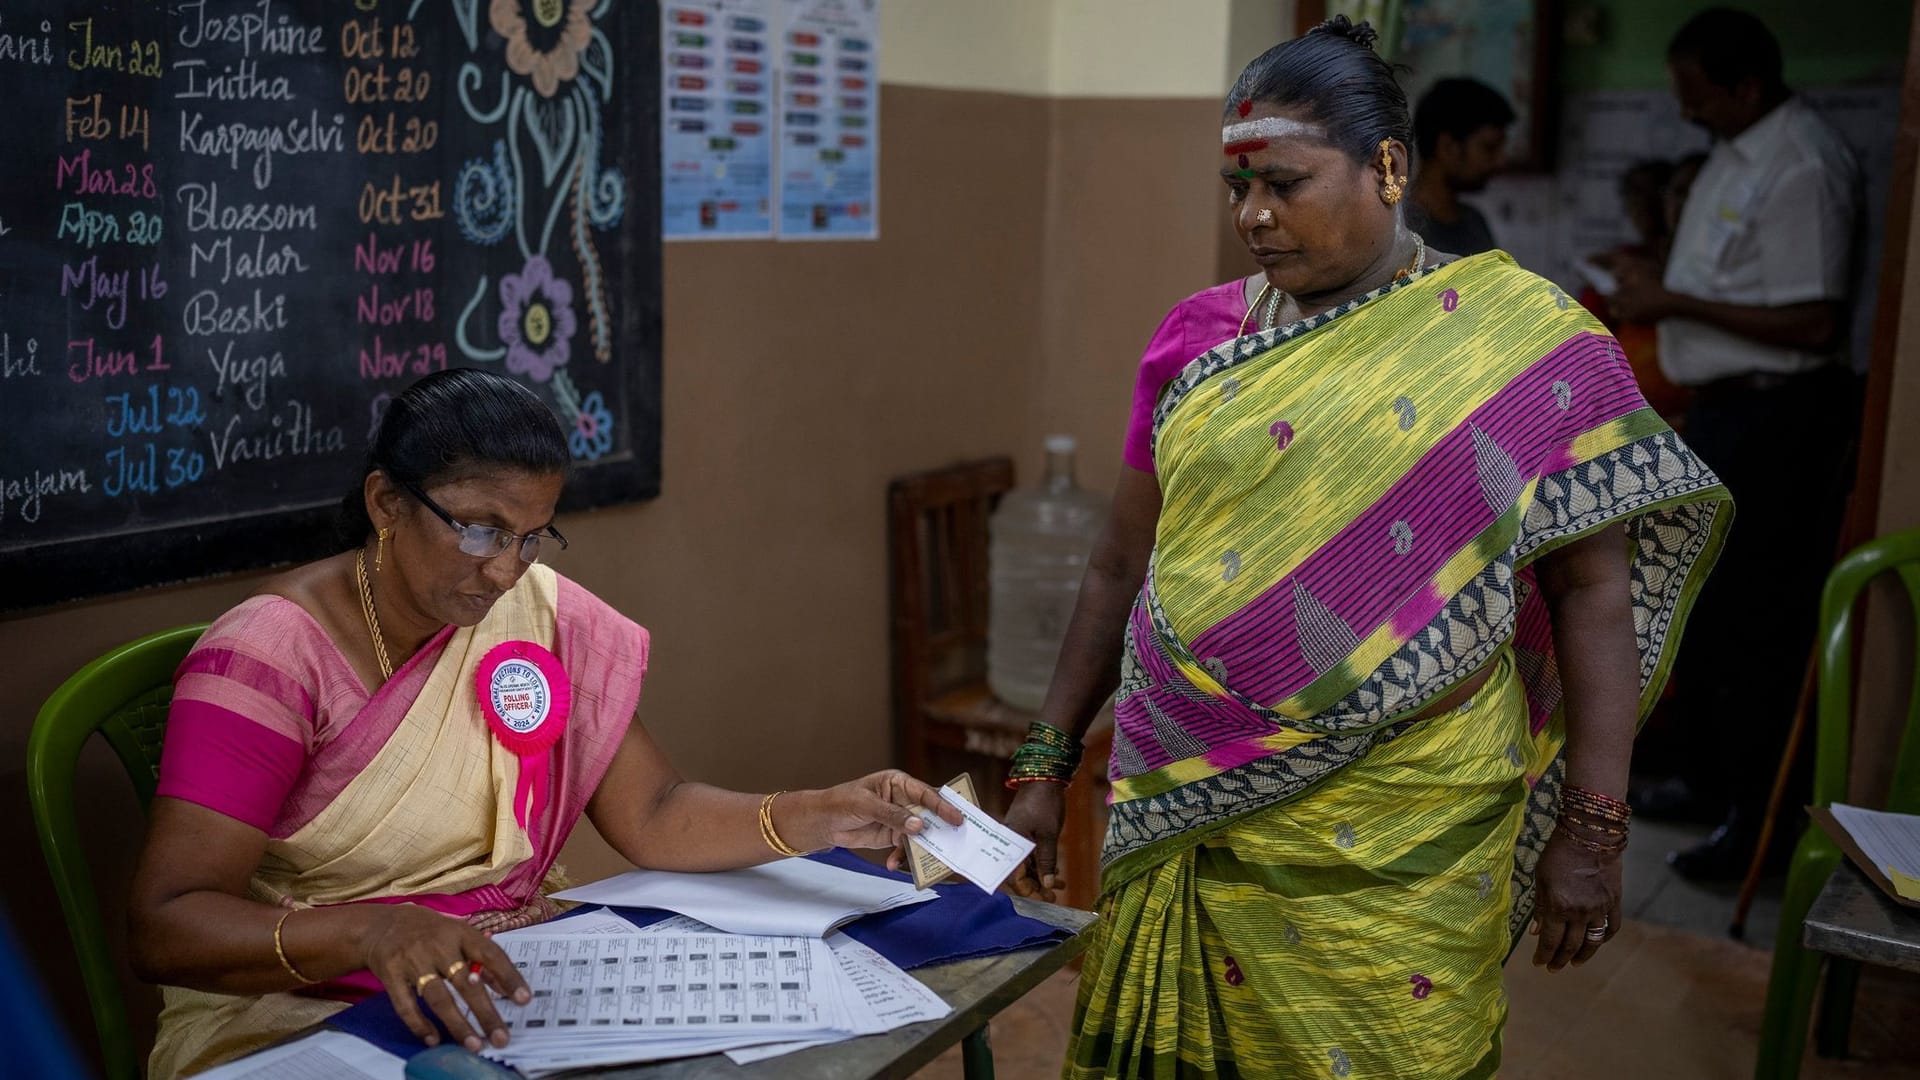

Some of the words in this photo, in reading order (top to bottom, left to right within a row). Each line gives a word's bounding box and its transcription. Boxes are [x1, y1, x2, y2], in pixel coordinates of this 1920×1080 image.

[0, 19, 54, 65] ani
[68, 17, 124, 71] Jan
[128, 40, 163, 78] 22
[178, 0, 326, 57] Josphine
[342, 17, 384, 58] Oct
[391, 23, 420, 58] 12
[173, 59, 296, 101] Initha
[344, 63, 391, 104] Oct
[396, 69, 431, 102] 20
[66, 93, 111, 143] Feb
[119, 104, 149, 151] 14
[357, 112, 396, 154] Oct
[402, 119, 439, 153] 20
[56, 149, 119, 195] Mar
[121, 163, 157, 199] 28
[177, 181, 317, 232] Blossom
[358, 175, 406, 224] Oct
[409, 180, 446, 221] 31
[57, 202, 120, 248] Apr
[126, 211, 163, 245] 20
[190, 235, 310, 284] Malar
[355, 231, 404, 274] Nov
[411, 239, 435, 273] 16
[61, 255, 129, 330] May
[141, 262, 168, 300] 16
[183, 288, 288, 336] Beski
[357, 283, 411, 325] Nov
[415, 288, 434, 322] 18
[0, 333, 41, 379] hi
[68, 338, 138, 383] Jun
[146, 334, 171, 371] 1
[208, 340, 287, 411] Yuga
[359, 335, 411, 379] Nov
[412, 342, 447, 375] 29
[105, 384, 163, 437] Jul
[166, 386, 207, 427] 22
[210, 400, 345, 471] Vanitha
[103, 444, 158, 497] Jul
[165, 448, 205, 488] 30
[503, 693, 530, 702] POLLING
[522, 669, 532, 679] TO
